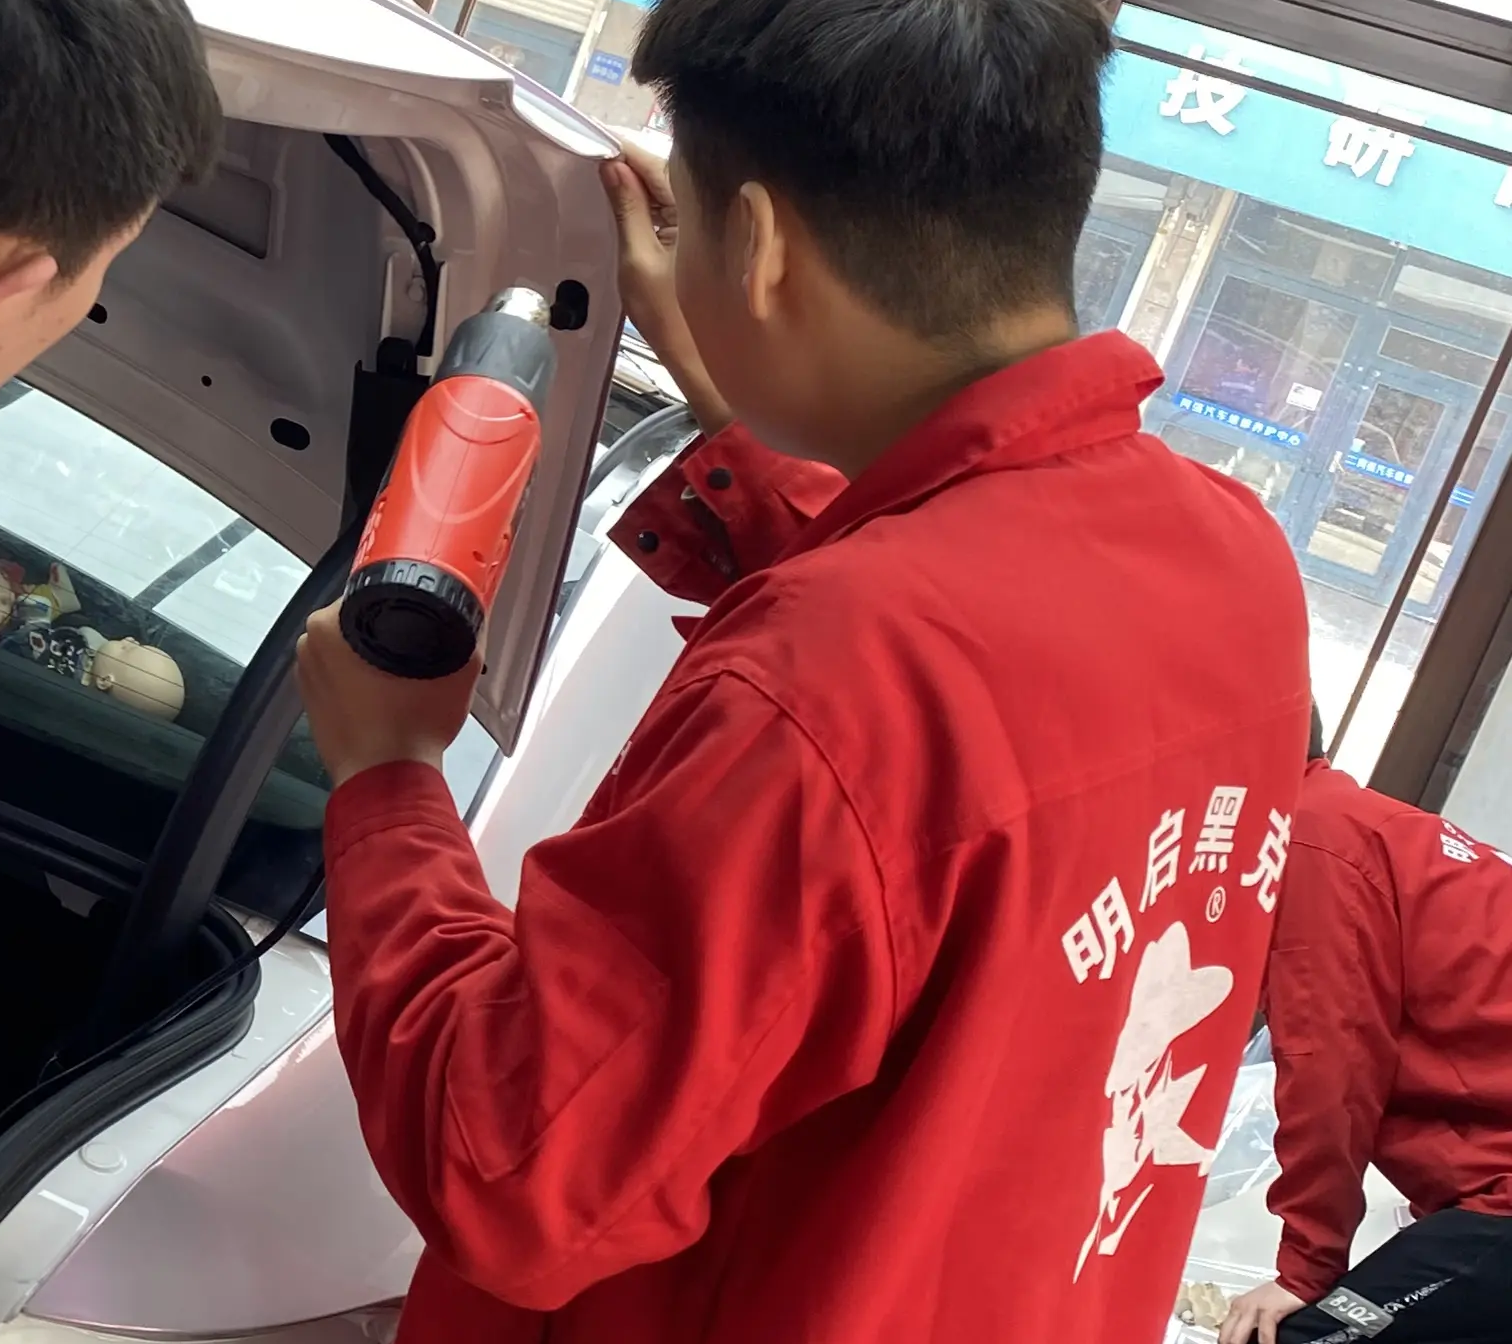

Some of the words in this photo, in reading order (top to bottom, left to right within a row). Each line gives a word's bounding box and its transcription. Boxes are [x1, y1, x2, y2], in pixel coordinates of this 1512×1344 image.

[1158, 43, 1512, 208] 技研
[1061, 785, 1292, 984] 明启黑克
[1329, 1295, 1379, 1327] BJQZ
